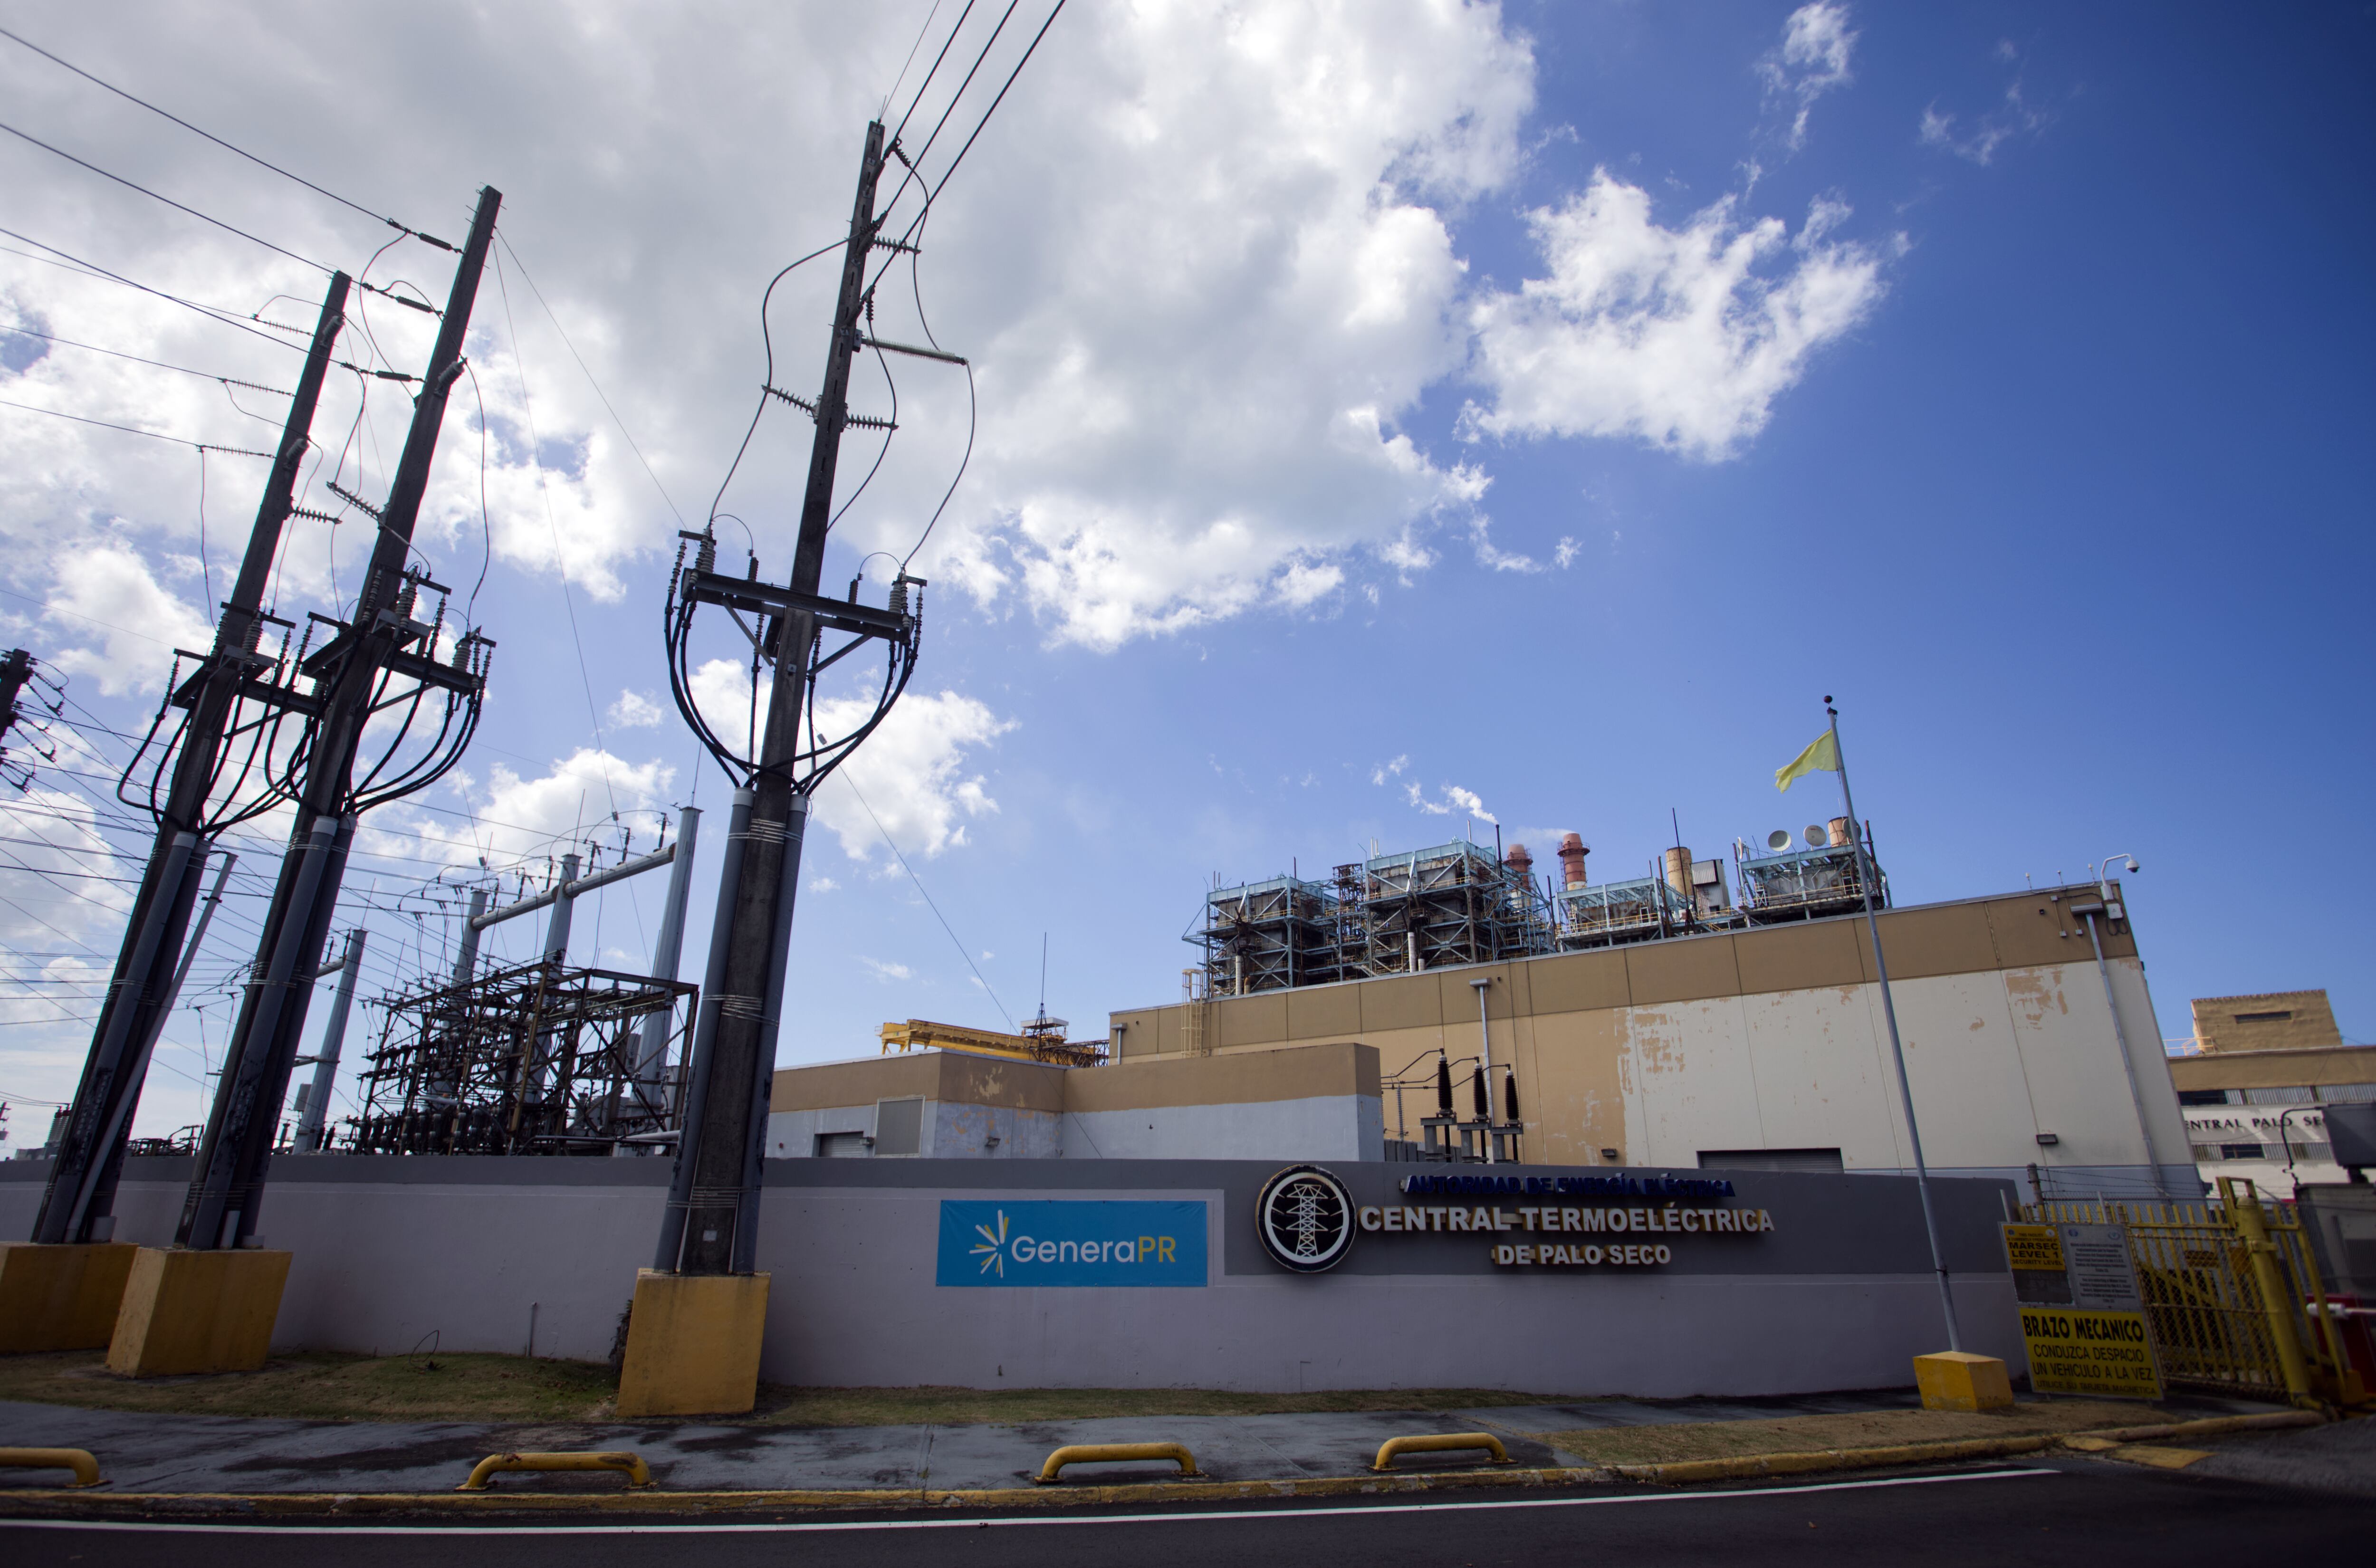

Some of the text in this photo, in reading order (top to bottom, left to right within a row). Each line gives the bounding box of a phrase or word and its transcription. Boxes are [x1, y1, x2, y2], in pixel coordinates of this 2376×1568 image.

[2252, 1117, 2292, 1127] PALO
[2303, 1116, 2325, 1126] SE
[1405, 1173, 1735, 1197] AUTORIDAD DE ENERGÍA ELÉCTRICA
[1360, 1202, 1775, 1232] CENTRAL TERMOELÉCTRICA
[1495, 1245, 1671, 1265] DE PALO SECO
[2009, 1242, 2058, 1250] MARSEC
[2011, 1250, 2050, 1258] LEVEL
[2022, 1315, 2144, 1342] BRAZO MECANICO
[2033, 1344, 2144, 1362] CONDUZCA DESPACIO
[2032, 1362, 2154, 1381] UN VEHICULO A LA VEZ
[2036, 1380, 2156, 1395] UTILICE SU TARJETA MAGNETICA
